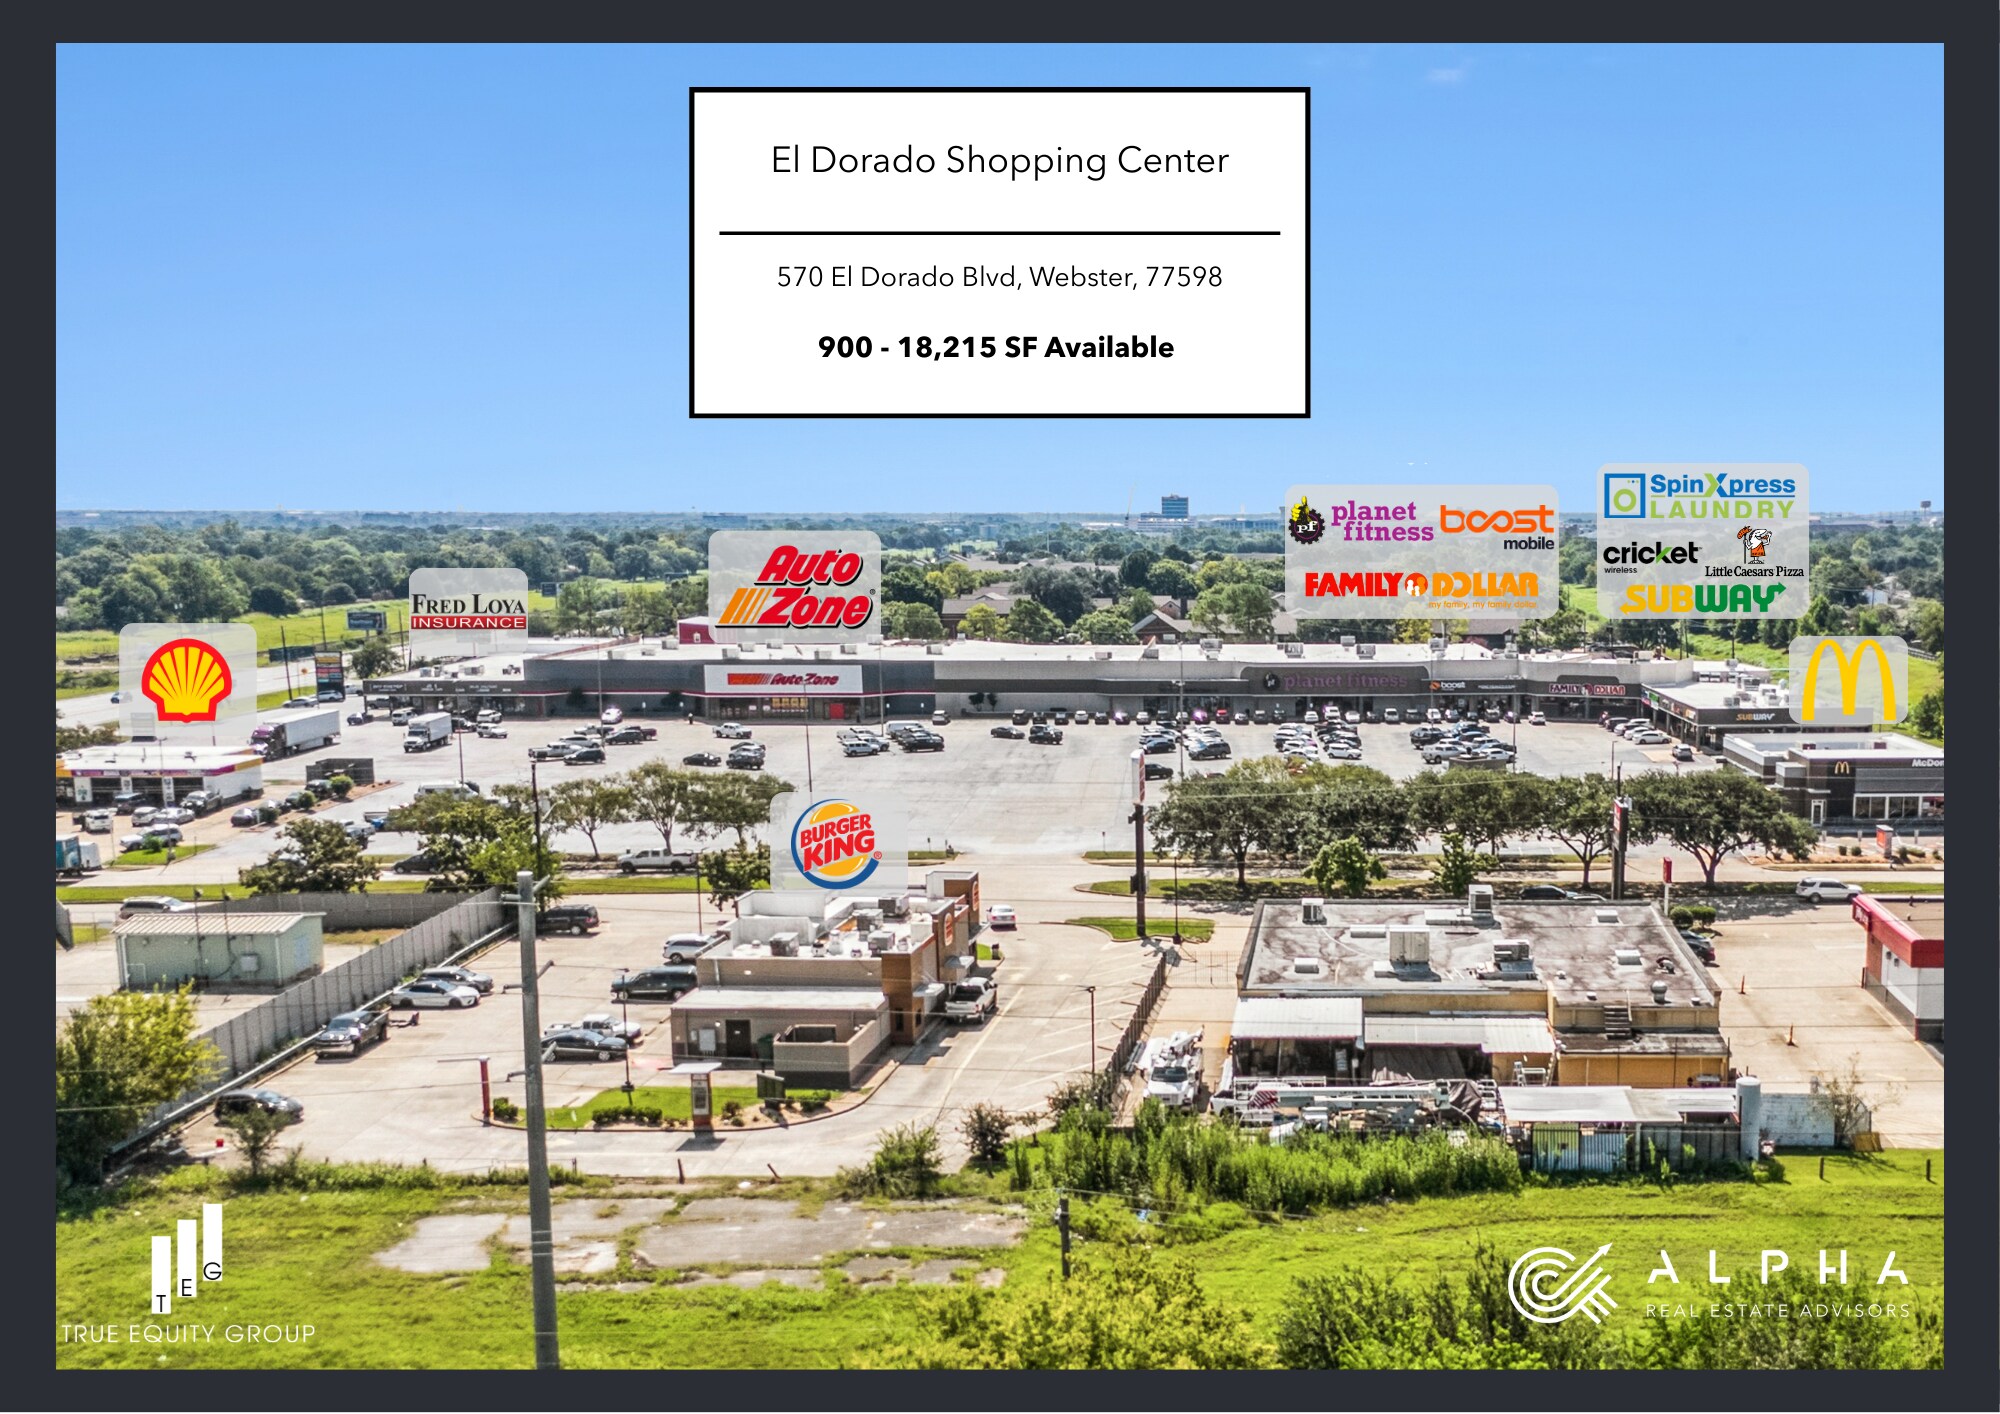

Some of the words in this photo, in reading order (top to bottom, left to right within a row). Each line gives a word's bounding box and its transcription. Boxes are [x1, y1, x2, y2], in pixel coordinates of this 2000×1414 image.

[1284, 672, 1343, 691] planet
[1440, 681, 1466, 689] boost
[1549, 683, 1582, 694] FAMILY
[1593, 684, 1626, 696] DOLLAR
[1736, 713, 1775, 721] SUBWAY
